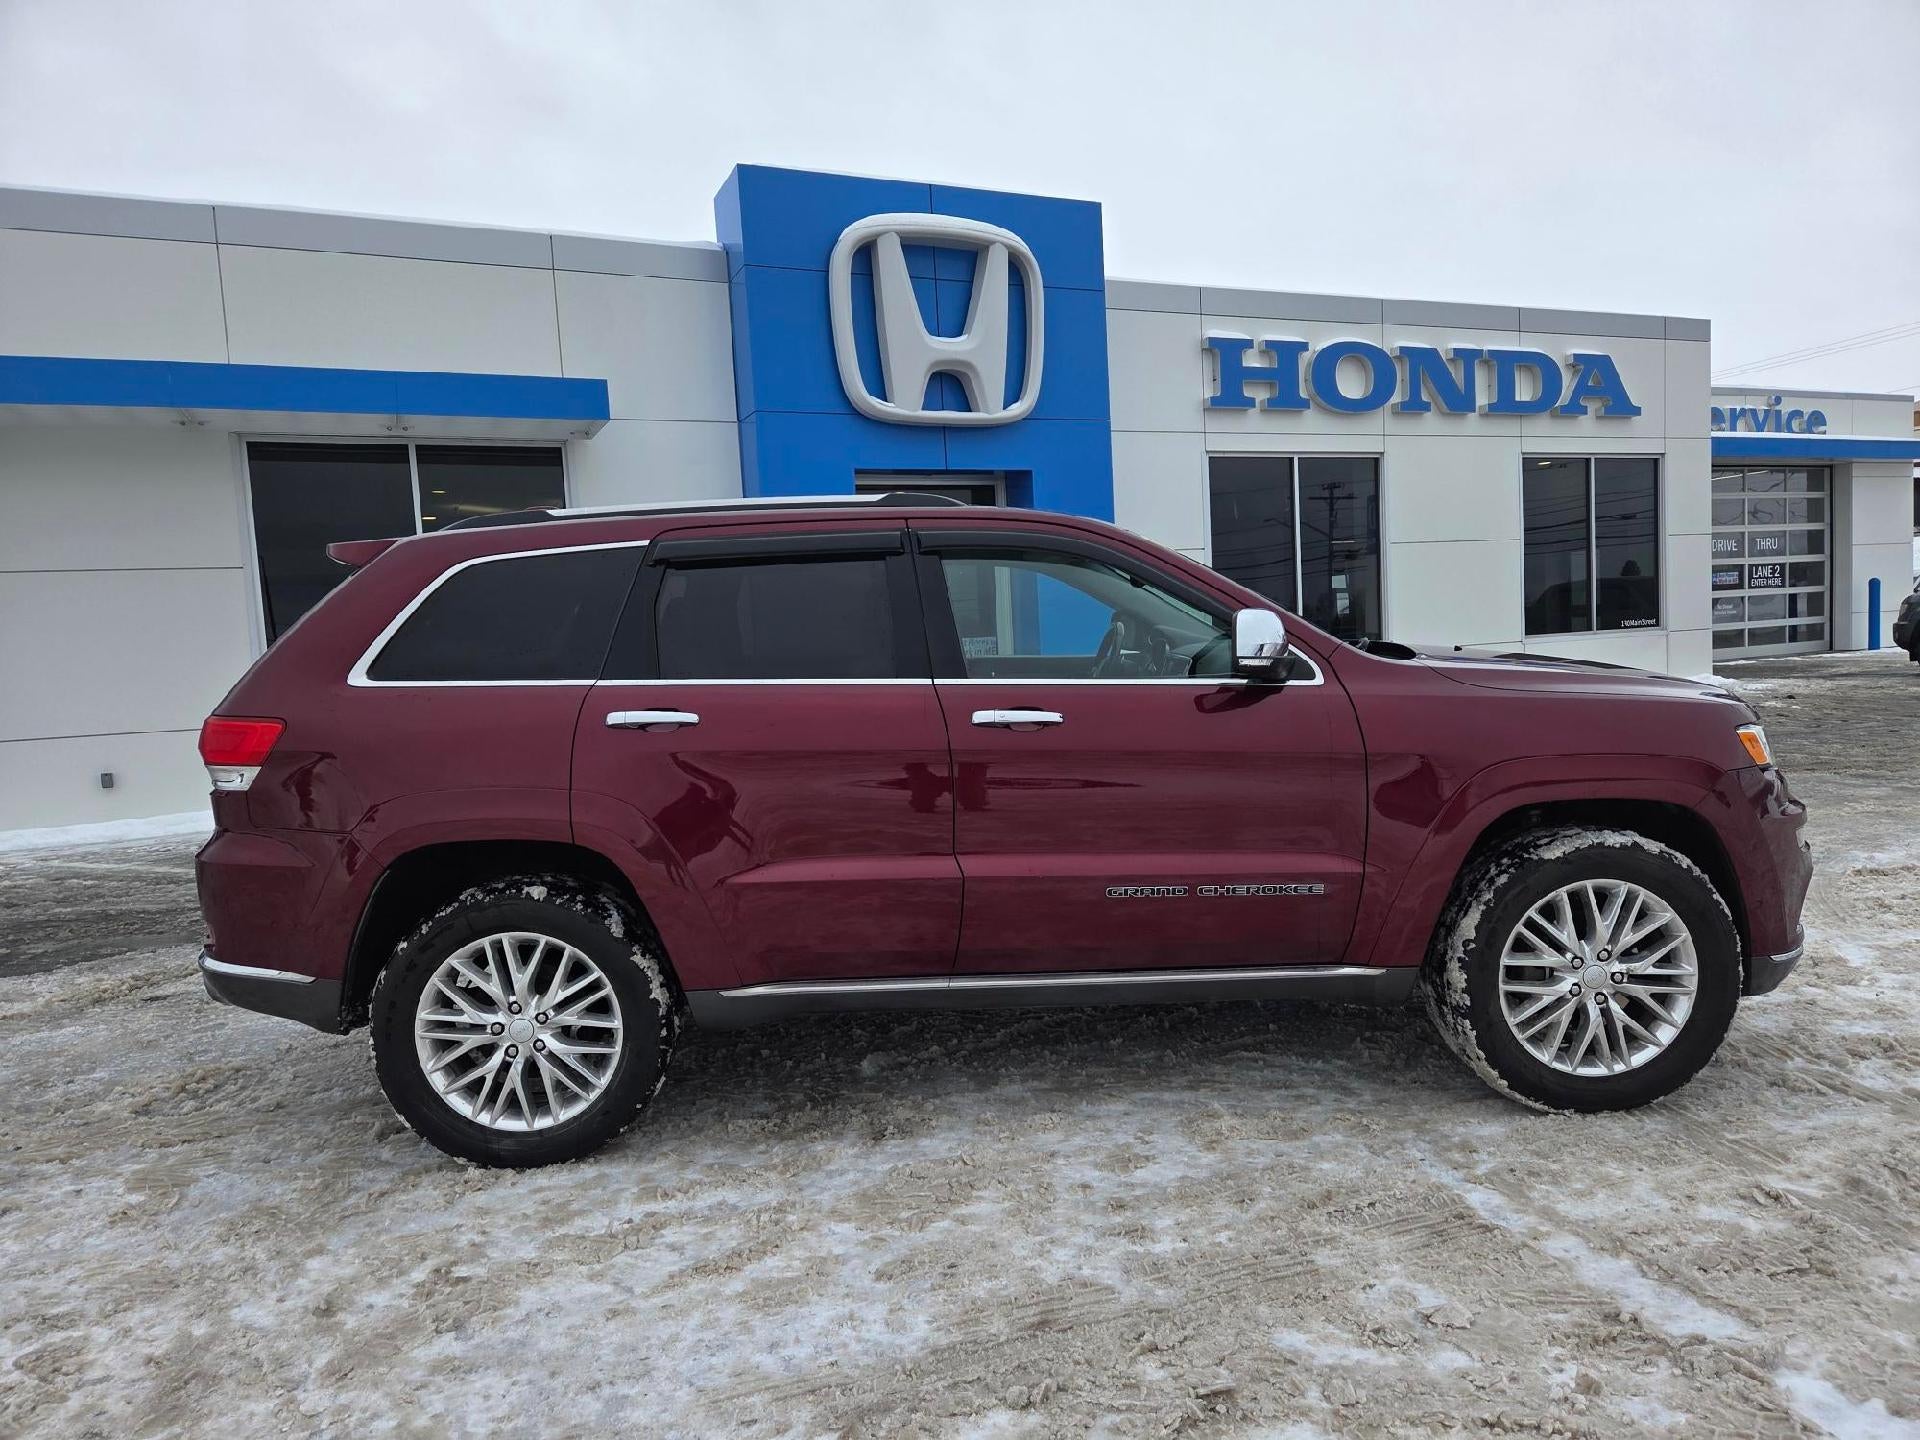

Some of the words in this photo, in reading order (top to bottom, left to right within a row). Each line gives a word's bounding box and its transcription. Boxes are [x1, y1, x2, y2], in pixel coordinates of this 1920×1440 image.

[1202, 334, 1642, 418] HONDA
[1712, 538, 1738, 551] DRIVE
[1755, 537, 1778, 550] THRU
[1752, 565, 1774, 578] LANE
[1774, 564, 1781, 577] 2
[1751, 578, 1767, 587] ENTER
[1767, 577, 1782, 586] HERE
[1106, 886, 1188, 897] GRAND
[1197, 884, 1324, 896] CHEROKEE
